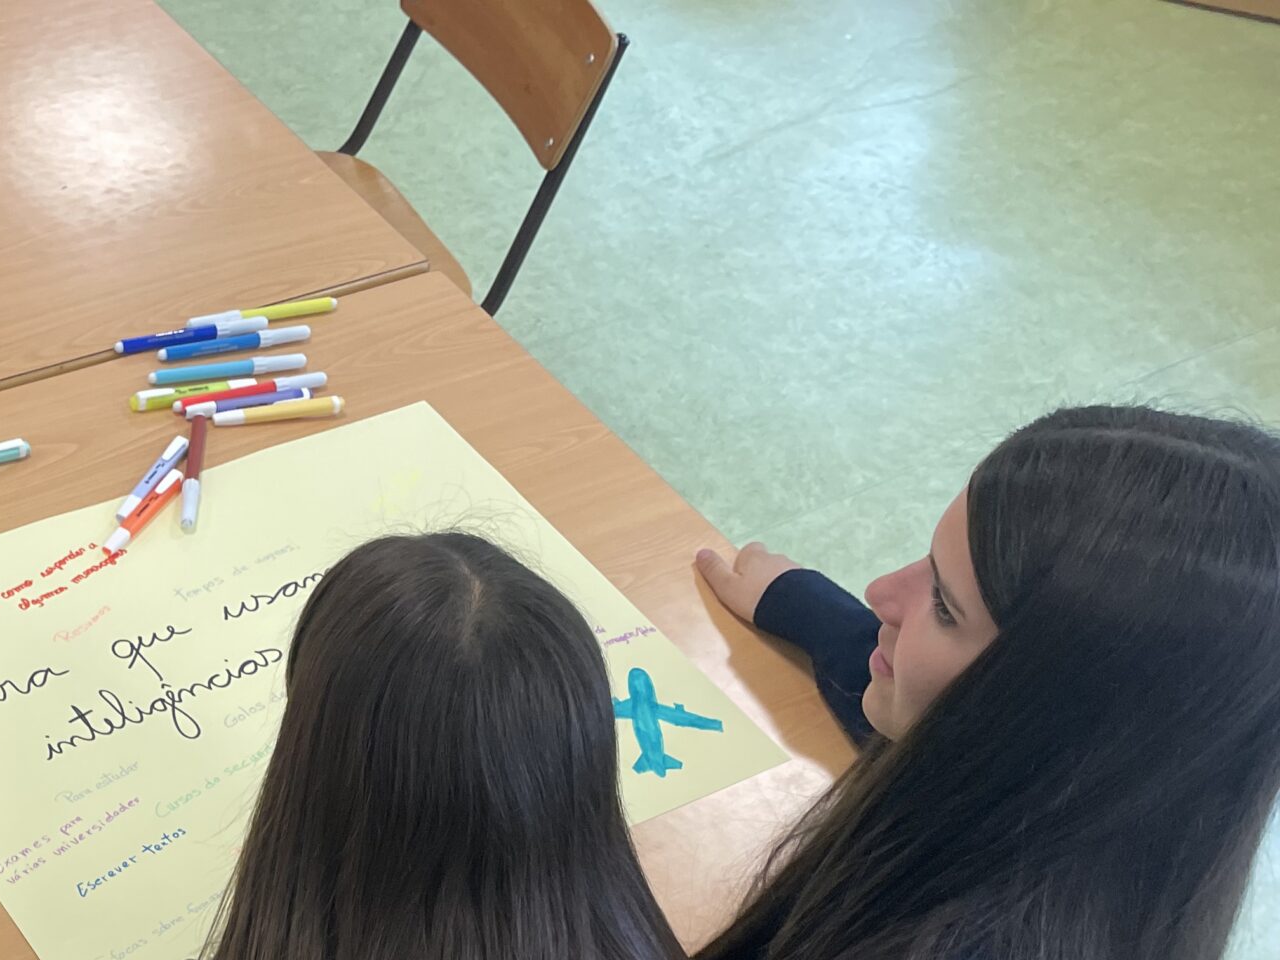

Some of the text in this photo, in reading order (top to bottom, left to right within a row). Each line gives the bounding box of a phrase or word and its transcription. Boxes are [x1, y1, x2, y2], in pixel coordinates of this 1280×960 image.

[0, 579, 33, 599] como
[88, 542, 98, 550] a
[52, 605, 111, 642] Resumos
[111, 625, 193, 681] que
[45, 648, 283, 761] inteligências
[223, 702, 266, 729] Golos
[54, 761, 140, 804] Para estudar
[154, 788, 202, 818] Cursos
[5, 796, 141, 885] várias universidades
[59, 815, 84, 837] para
[76, 827, 188, 899] Escrever textos
